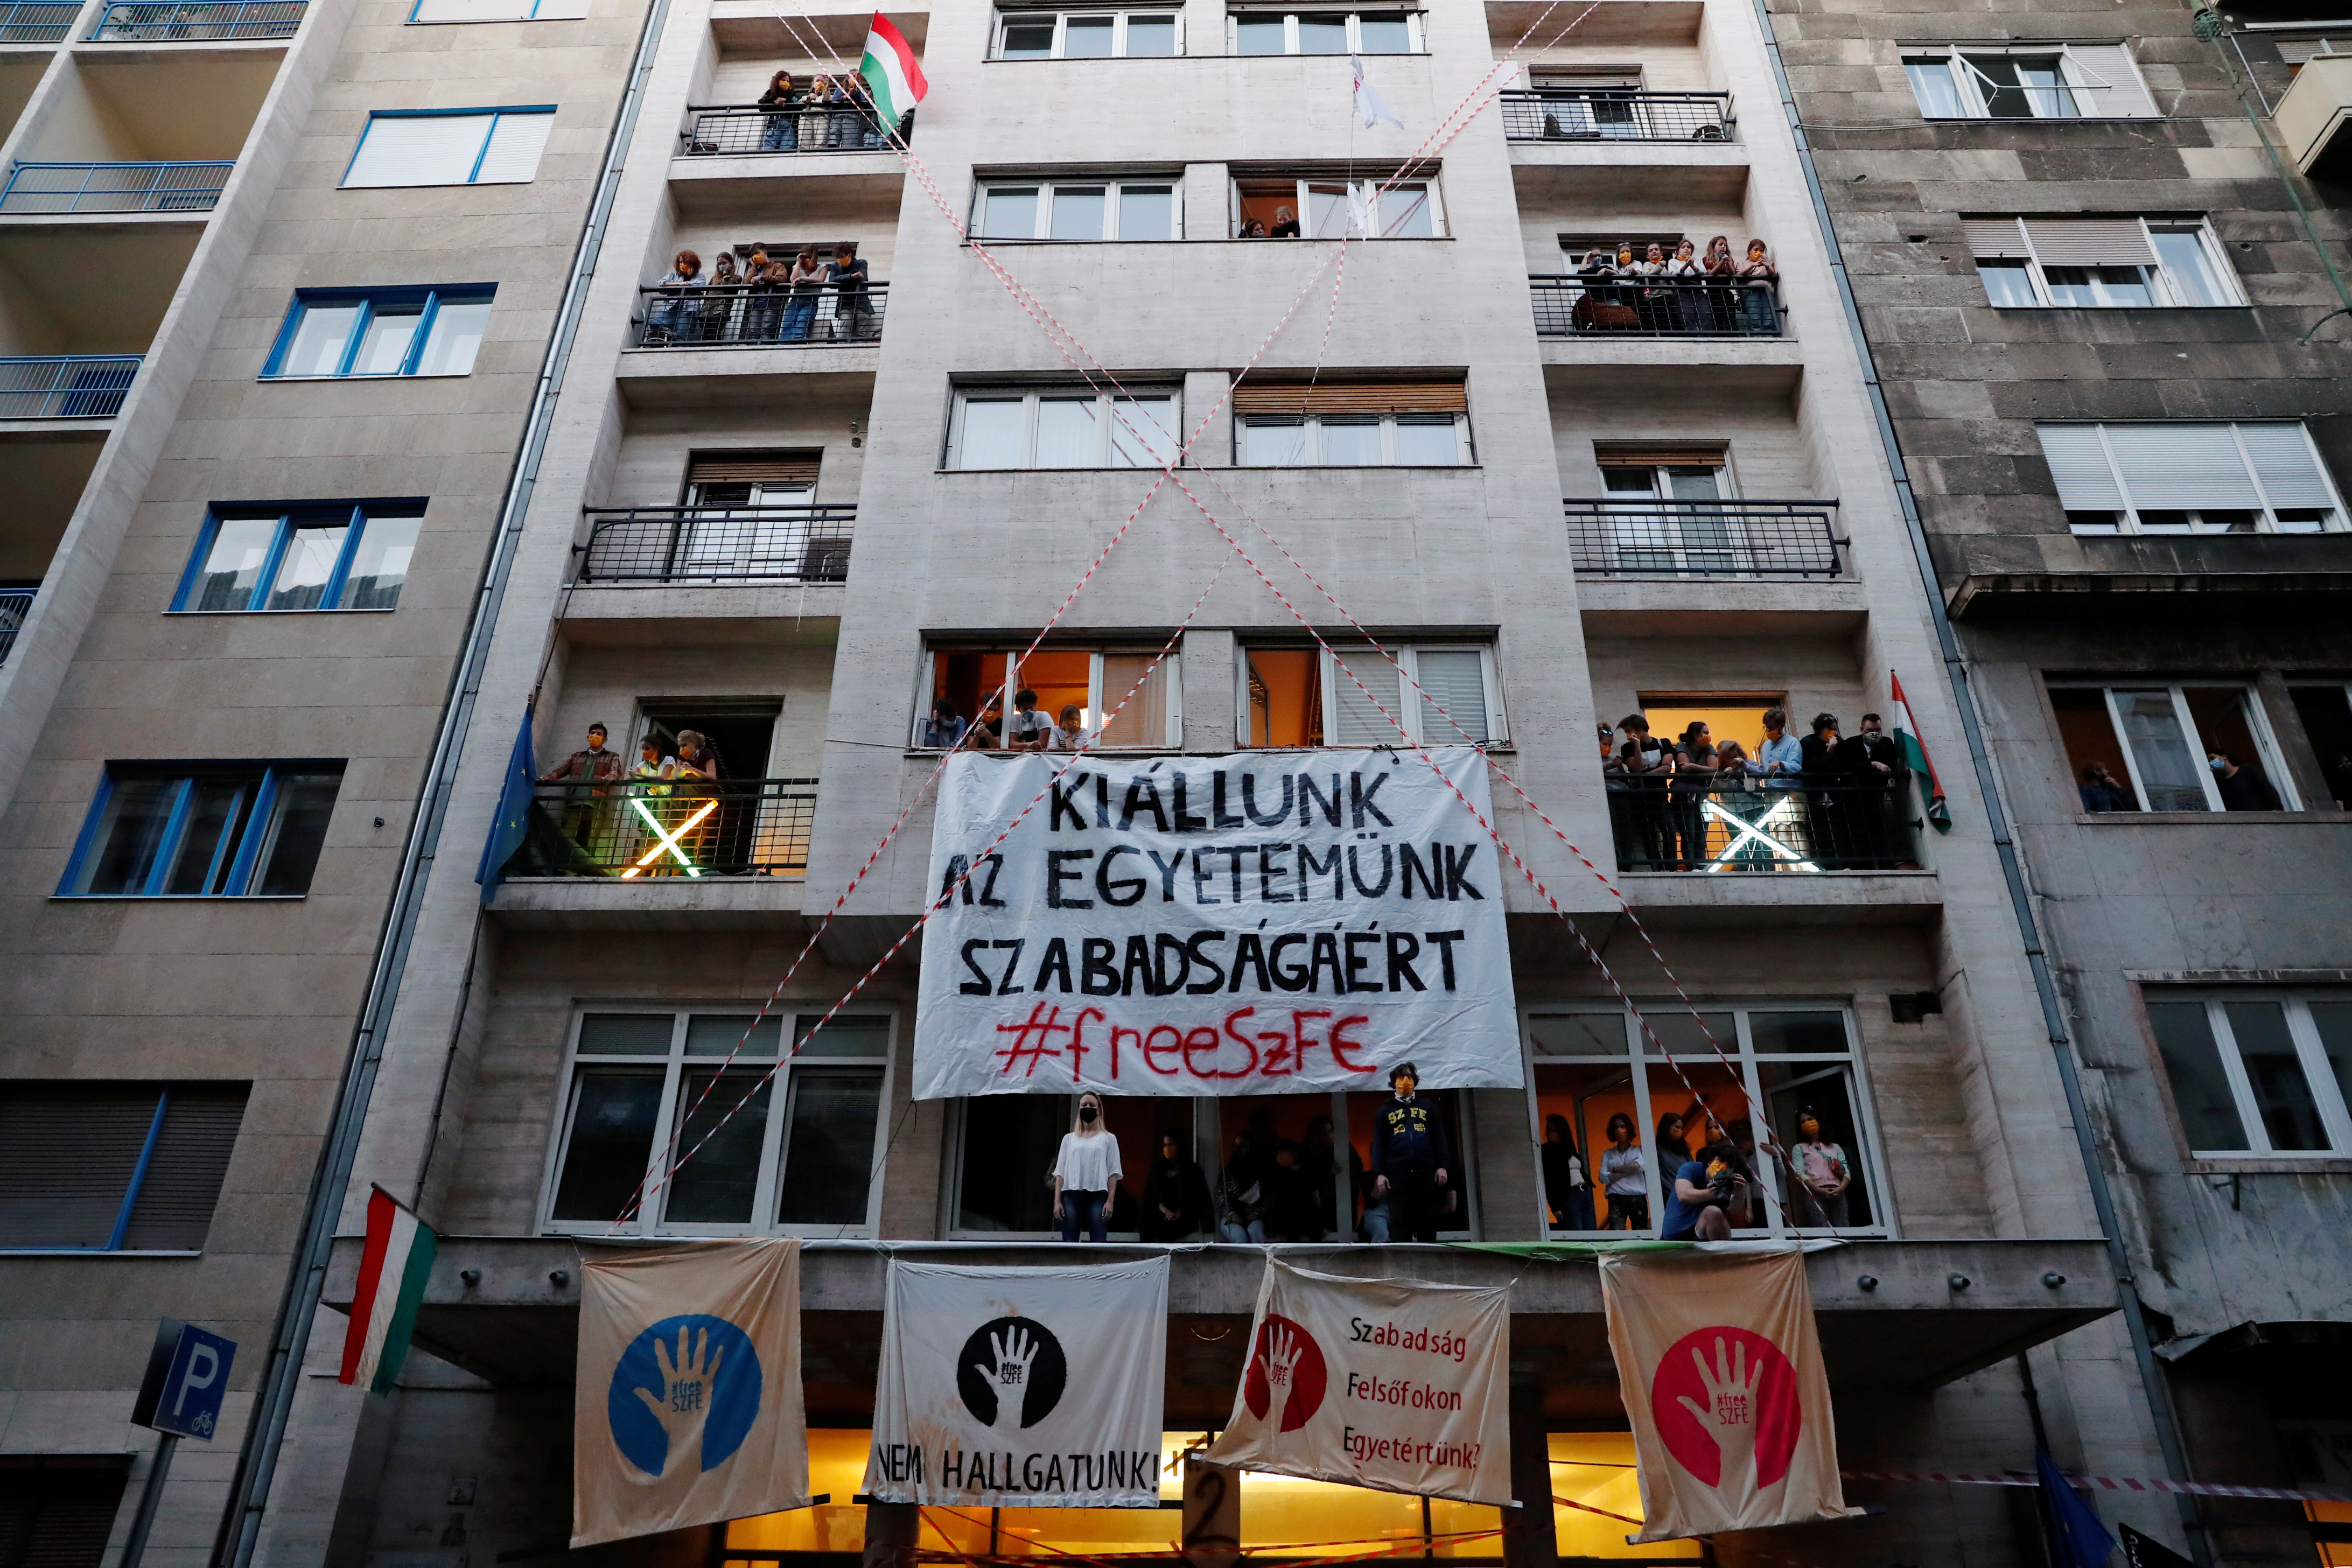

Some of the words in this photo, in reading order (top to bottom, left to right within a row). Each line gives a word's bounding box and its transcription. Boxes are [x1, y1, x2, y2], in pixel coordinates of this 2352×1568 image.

[1051, 762, 1394, 832] KIÁLLUNK
[940, 853, 1005, 909] AZ
[1047, 833, 1484, 910] EGYETEMÜNK
[960, 919, 1465, 996] SZABADSÁGÁÉRT
[996, 1002, 1377, 1081] #freeSzFE
[1350, 1317, 1466, 1362] Szabadság
[173, 1342, 219, 1416] P
[671, 1379, 702, 1395] #free
[1000, 1373, 1022, 1384] SZFE
[1001, 1362, 1022, 1373] #free
[672, 1394, 702, 1412] SZFE
[1347, 1373, 1461, 1411] Felsőfokon
[1717, 1392, 1747, 1407] #free
[1719, 1407, 1749, 1424] SZFE
[878, 1444, 921, 1483] NEM
[943, 1450, 1159, 1493] HALLGATUNK!
